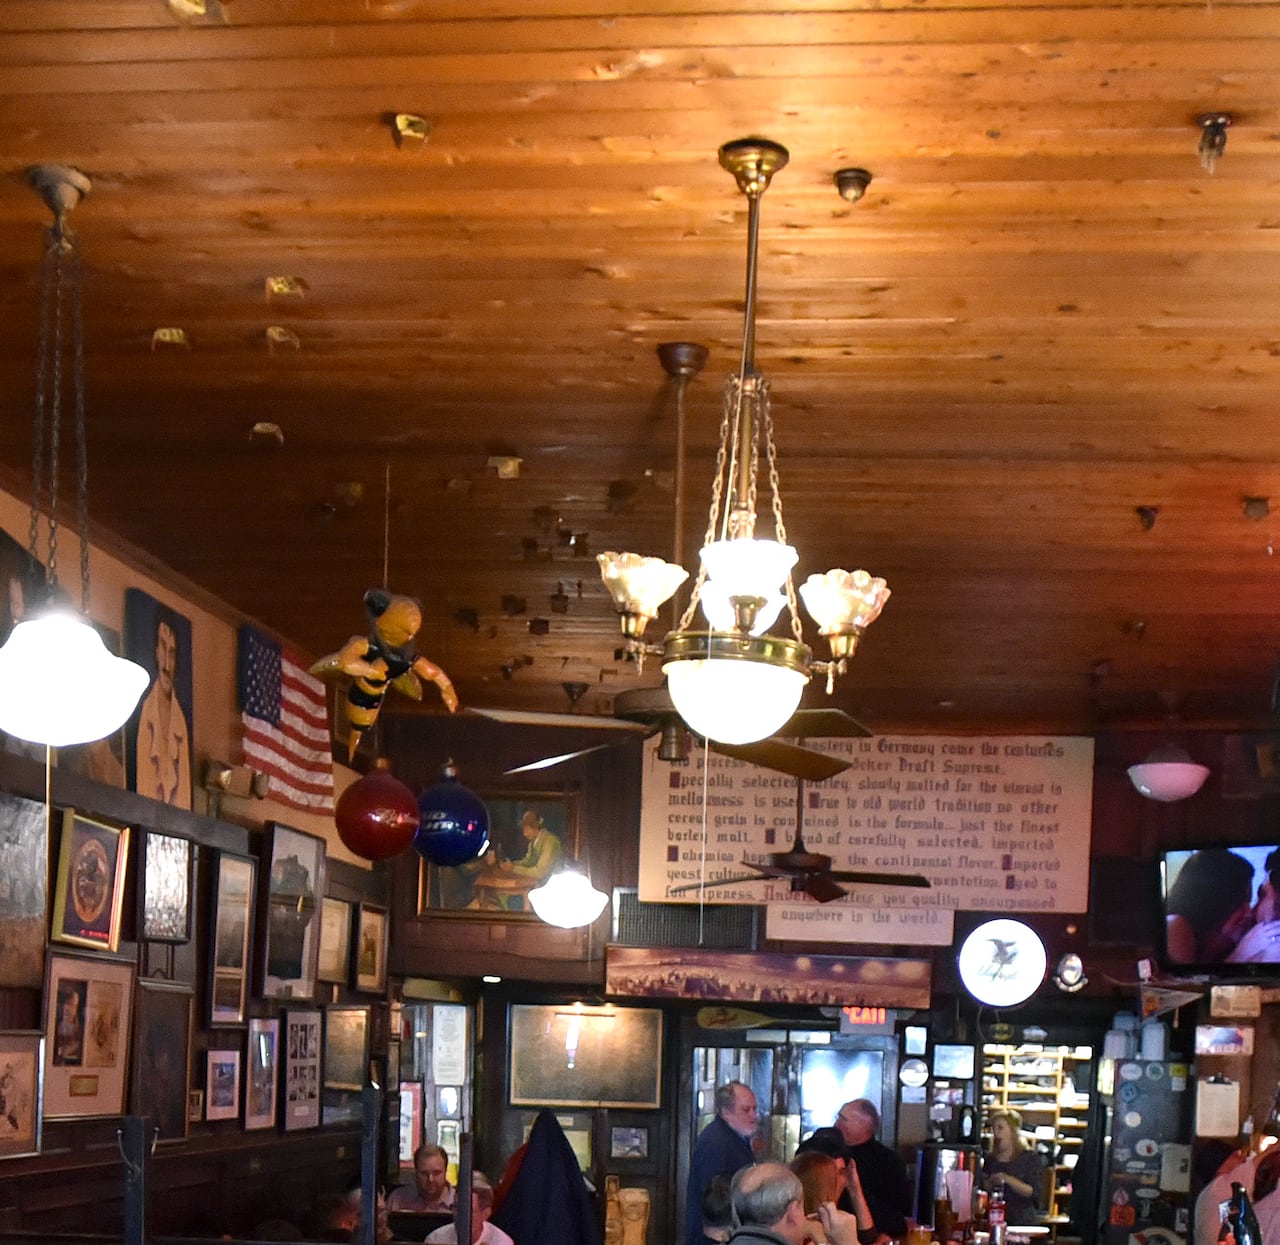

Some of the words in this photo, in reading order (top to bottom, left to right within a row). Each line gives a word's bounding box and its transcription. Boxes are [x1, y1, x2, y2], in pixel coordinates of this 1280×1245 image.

[877, 738, 936, 756] Germany
[696, 756, 746, 769] pocess
[899, 756, 934, 773] Draft
[773, 814, 840, 828] conained
